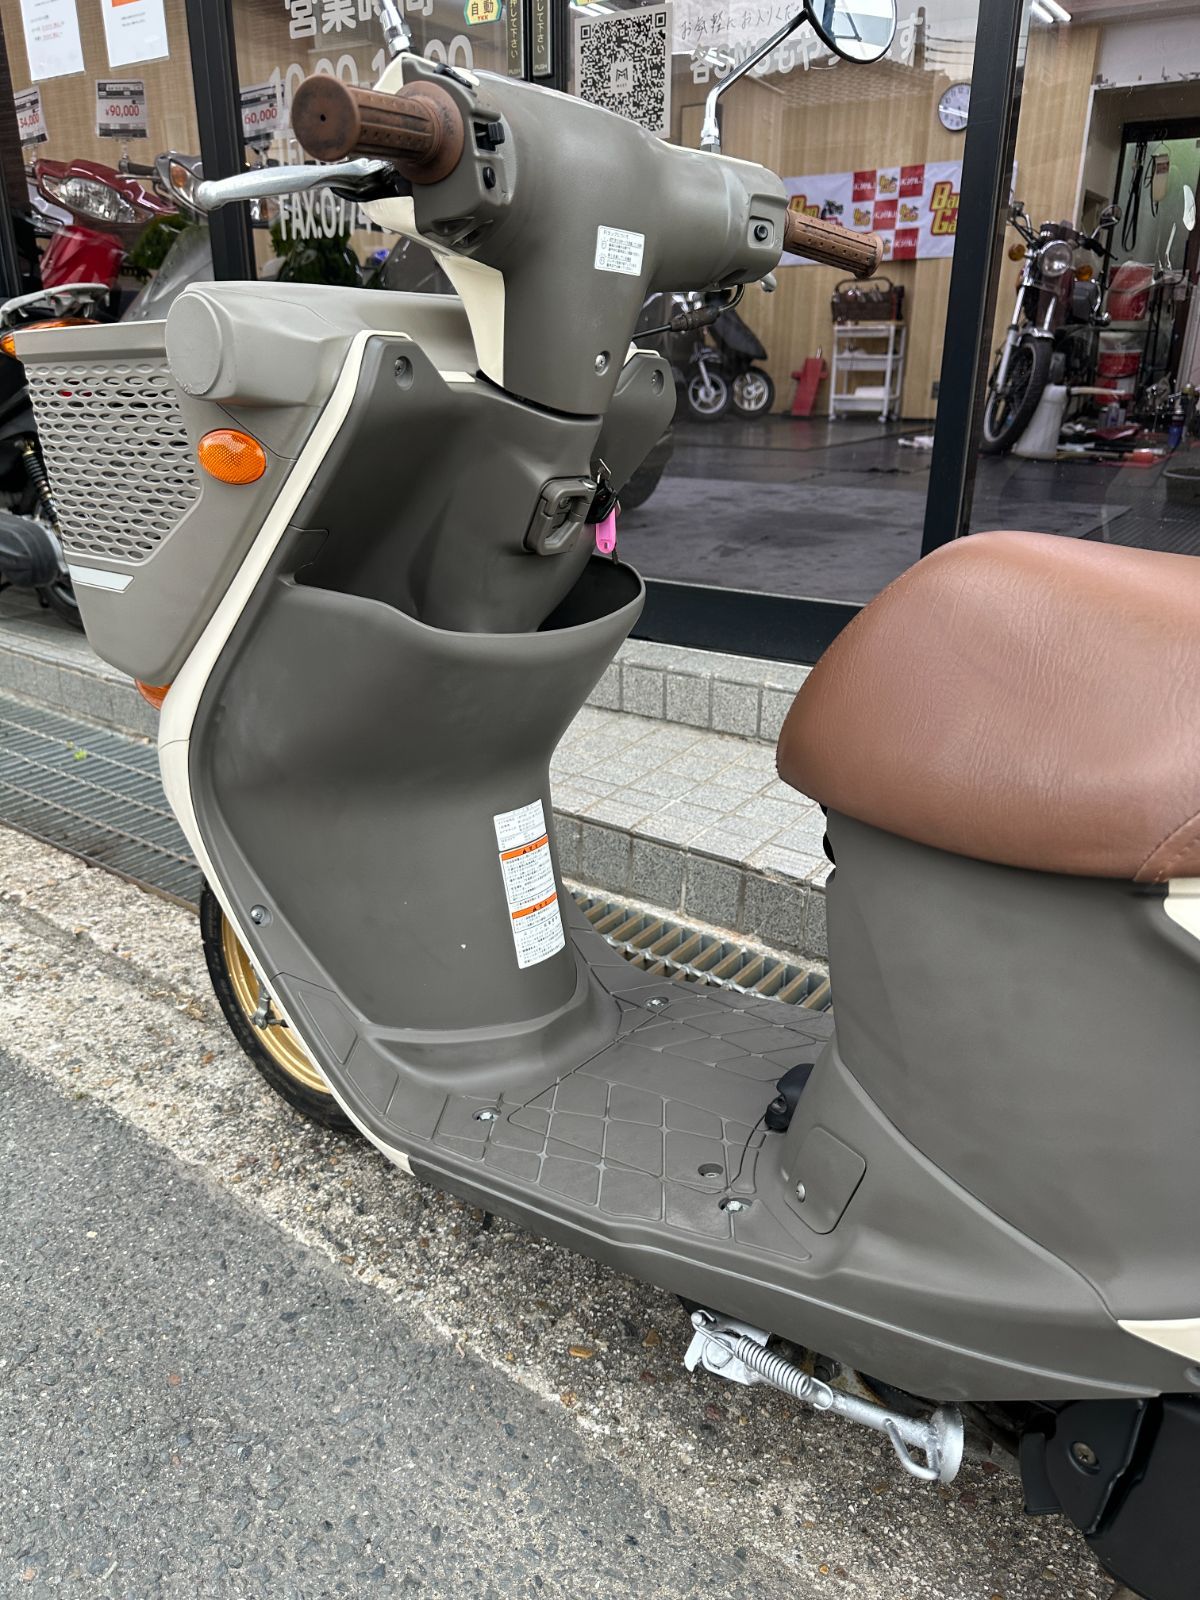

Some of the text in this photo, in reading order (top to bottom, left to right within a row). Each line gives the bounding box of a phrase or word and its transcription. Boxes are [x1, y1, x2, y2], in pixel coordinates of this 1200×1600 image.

[536, 0, 545, 54] して下さい
